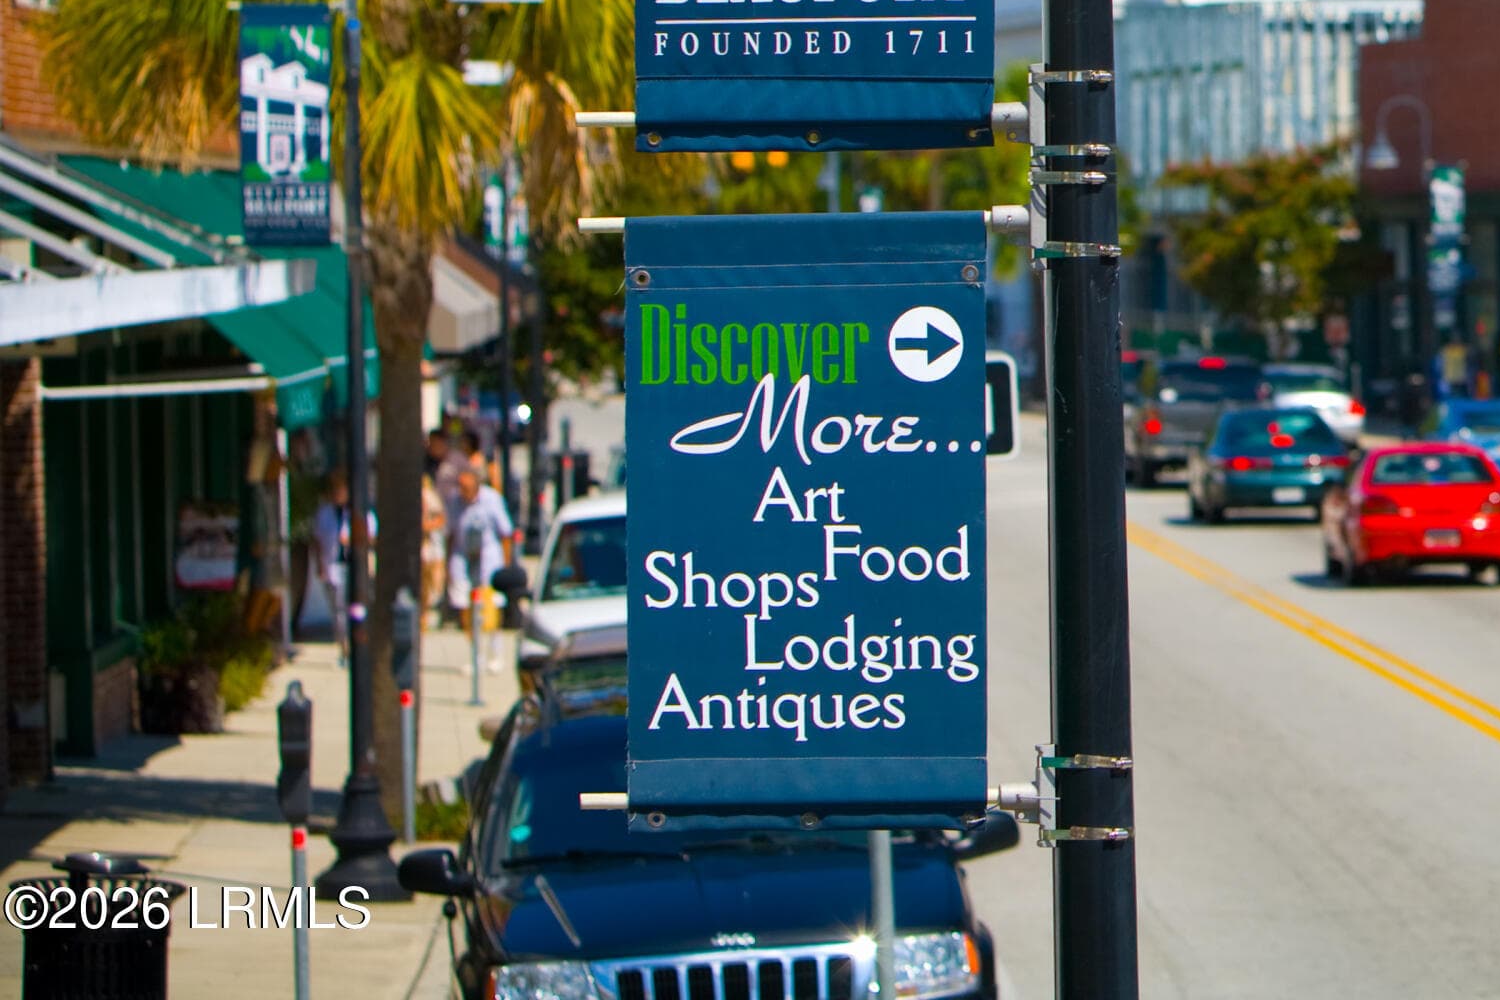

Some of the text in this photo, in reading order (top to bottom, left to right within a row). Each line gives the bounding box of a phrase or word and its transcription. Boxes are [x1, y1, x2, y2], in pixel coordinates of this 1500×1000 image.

[655, 31, 972, 55] FOUNDED 1711
[640, 303, 870, 385] Discover
[670, 373, 980, 465] More...
[753, 466, 845, 522] Art
[645, 551, 818, 620] Shops
[824, 525, 970, 581] Food
[744, 614, 978, 684] Lodging
[649, 674, 905, 741] Antiques
